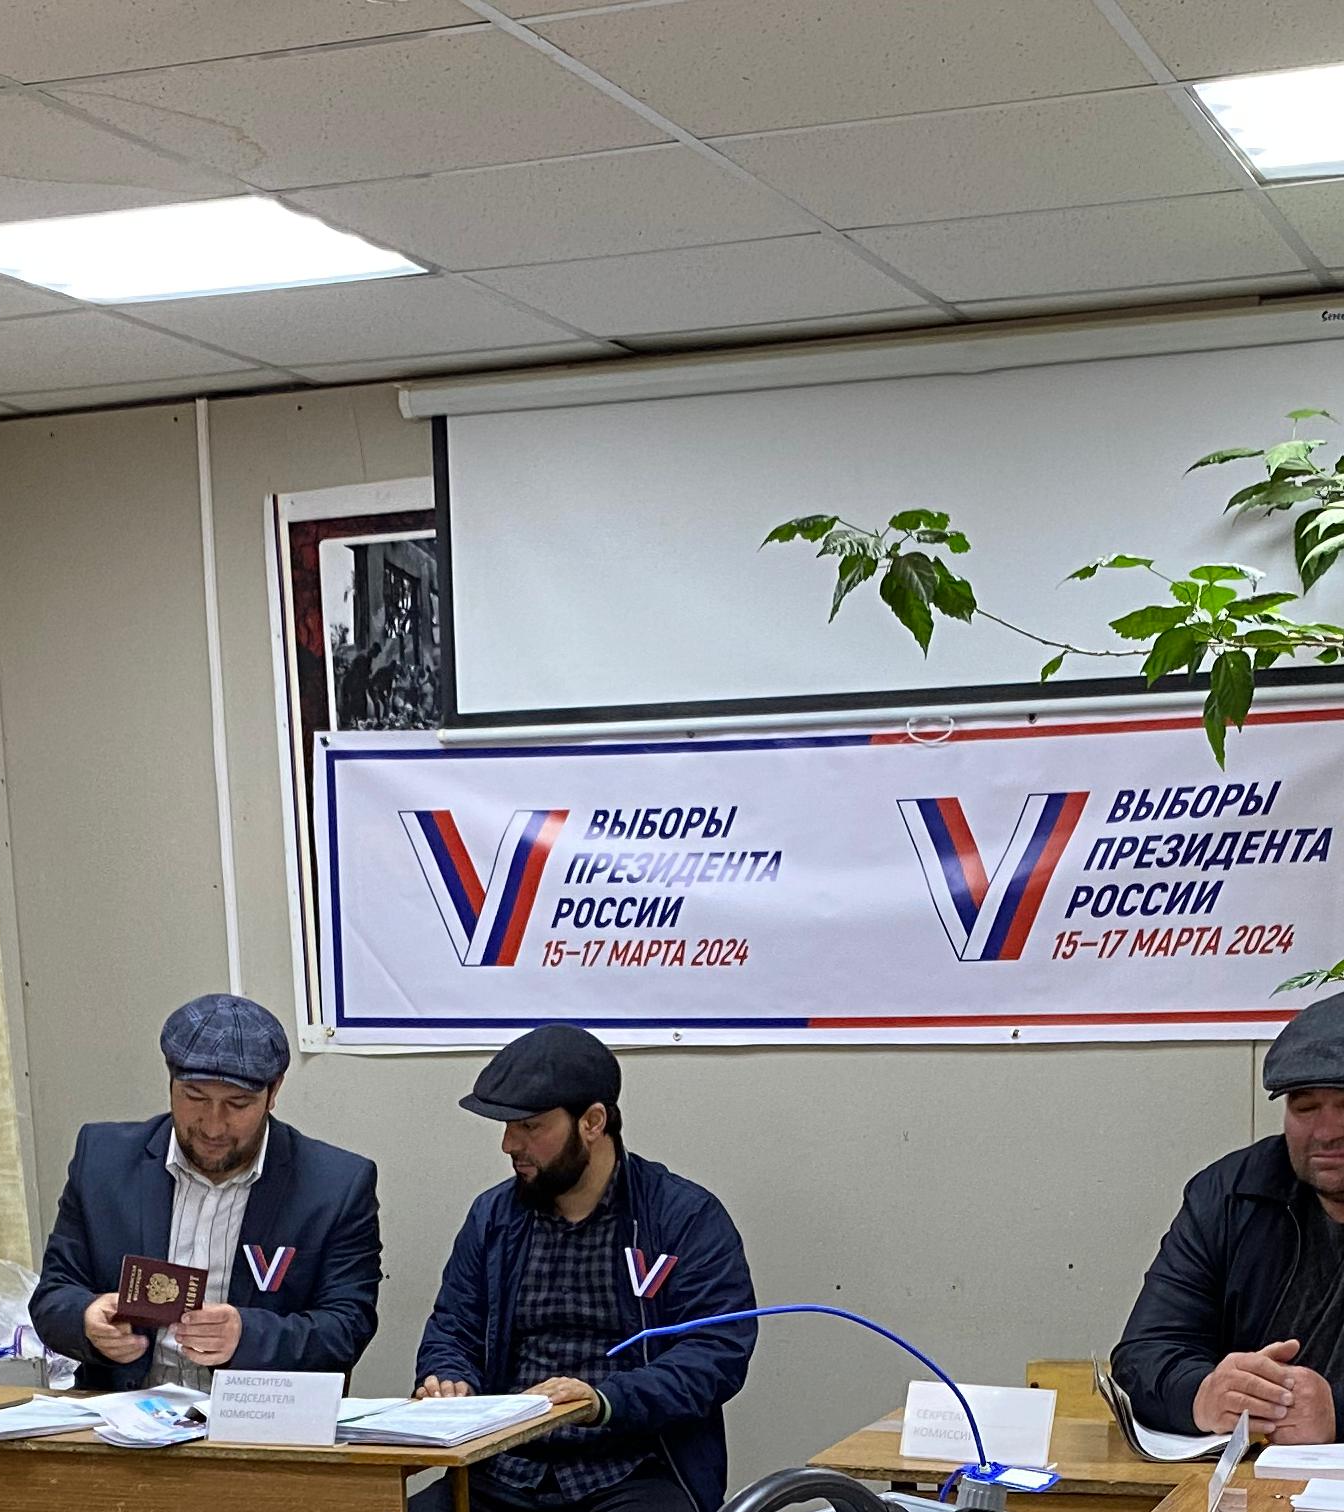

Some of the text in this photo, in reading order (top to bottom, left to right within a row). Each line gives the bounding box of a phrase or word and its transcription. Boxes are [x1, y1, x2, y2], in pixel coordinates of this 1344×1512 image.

[1105, 780, 1282, 824] ВЫБОРЫ
[584, 805, 739, 841] ВЫБОРЫ
[1083, 827, 1334, 871] ПРЕЗИДЕНТА
[563, 850, 784, 888] ПРЕЗИДЕНТА
[551, 897, 685, 929] РОССИИ
[1064, 880, 1225, 919] РОССИИ
[606, 939, 687, 967] МАРТА
[689, 938, 750, 967] 2024
[1127, 926, 1224, 959] МАРТА
[1225, 923, 1296, 956] 2024
[222, 1392, 296, 1404] ПРЕДСЕДАТЕЛЯ
[224, 1375, 294, 1388] ЗАМЕСТИТЕЛЬ
[219, 1408, 276, 1420] КОМИССИИ
[916, 1408, 967, 1422] СЕКРЕТА
